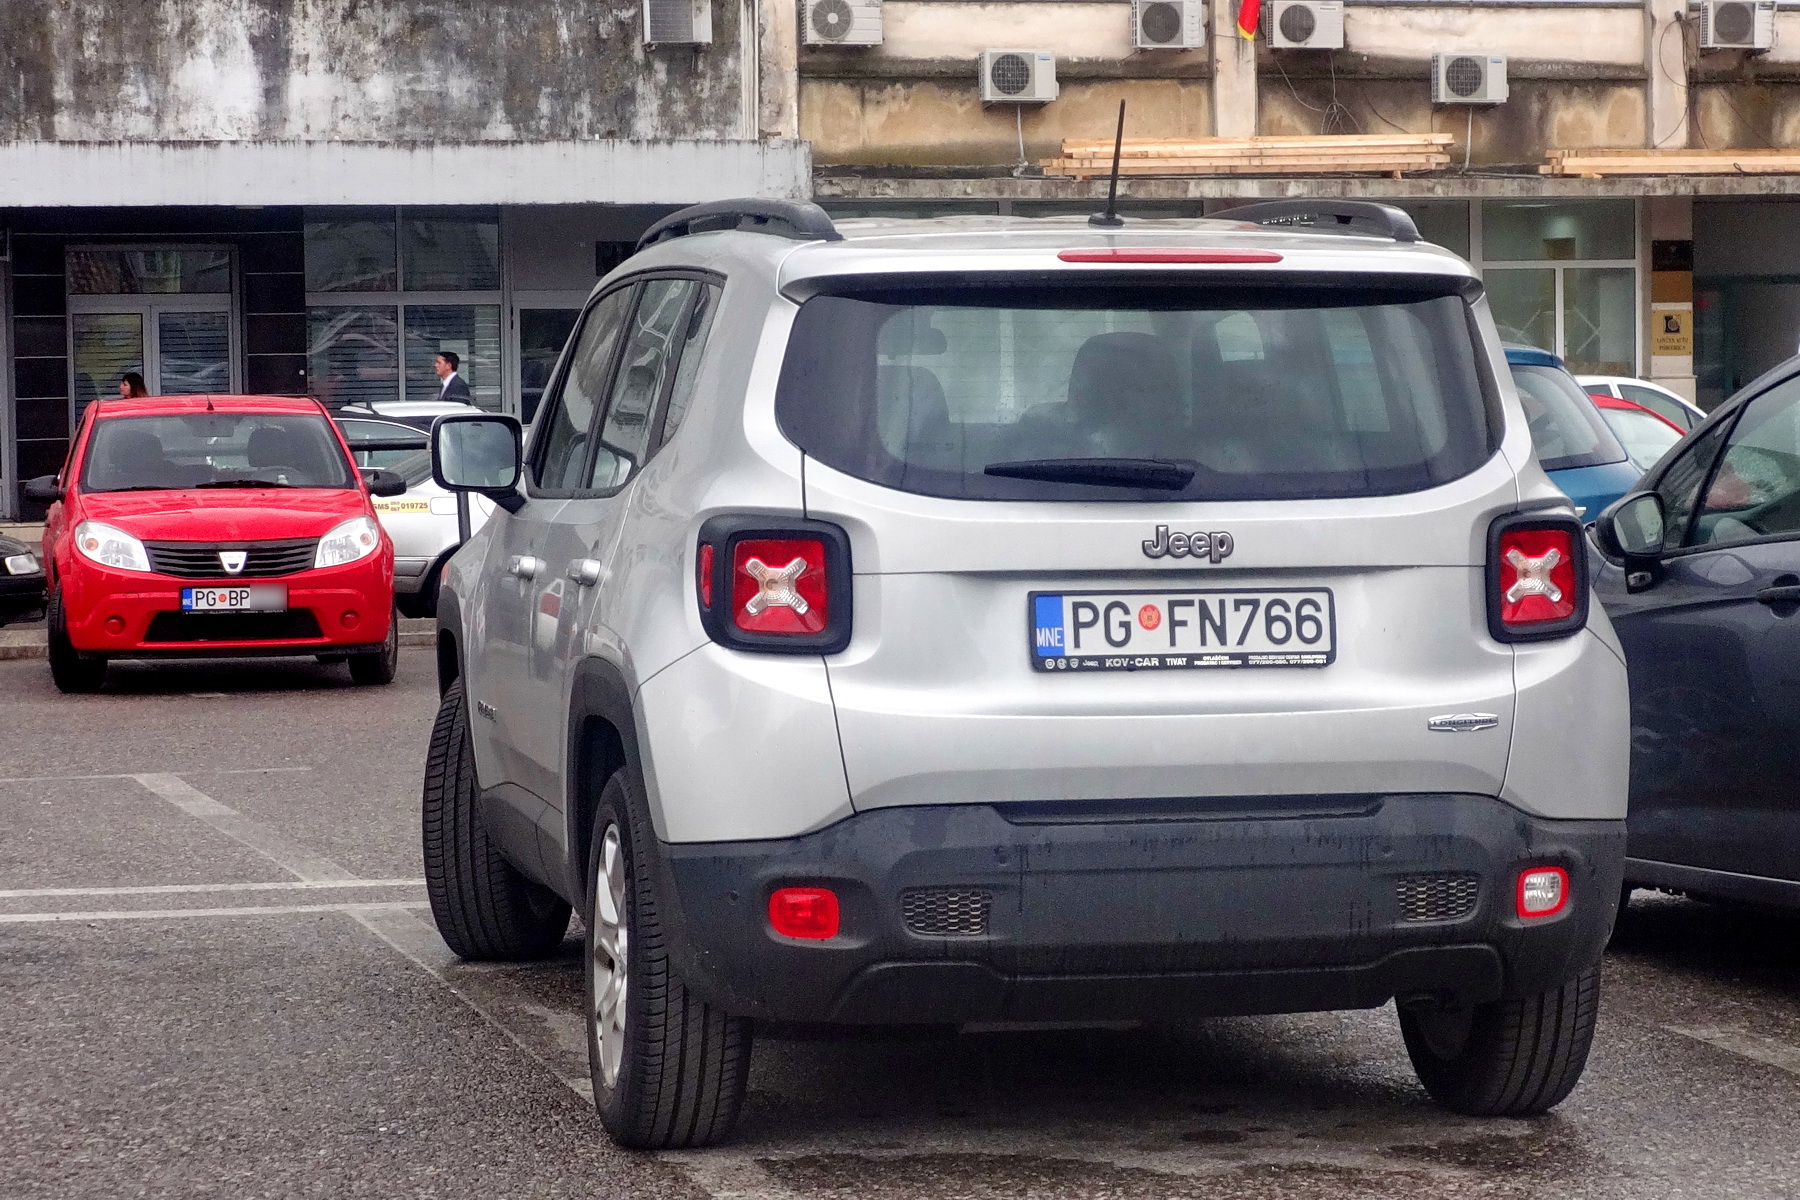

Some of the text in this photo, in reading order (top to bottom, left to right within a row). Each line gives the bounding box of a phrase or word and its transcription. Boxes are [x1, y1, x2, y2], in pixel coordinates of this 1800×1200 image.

[400, 502, 428, 510] 019725
[1142, 525, 1234, 564] Jeep
[195, 591, 216, 607] PG
[1071, 597, 1323, 649] PG FN766
[1036, 627, 1063, 648] MNE
[1105, 657, 1160, 668] KOV-CAR
[1165, 657, 1188, 666] TIVAT
